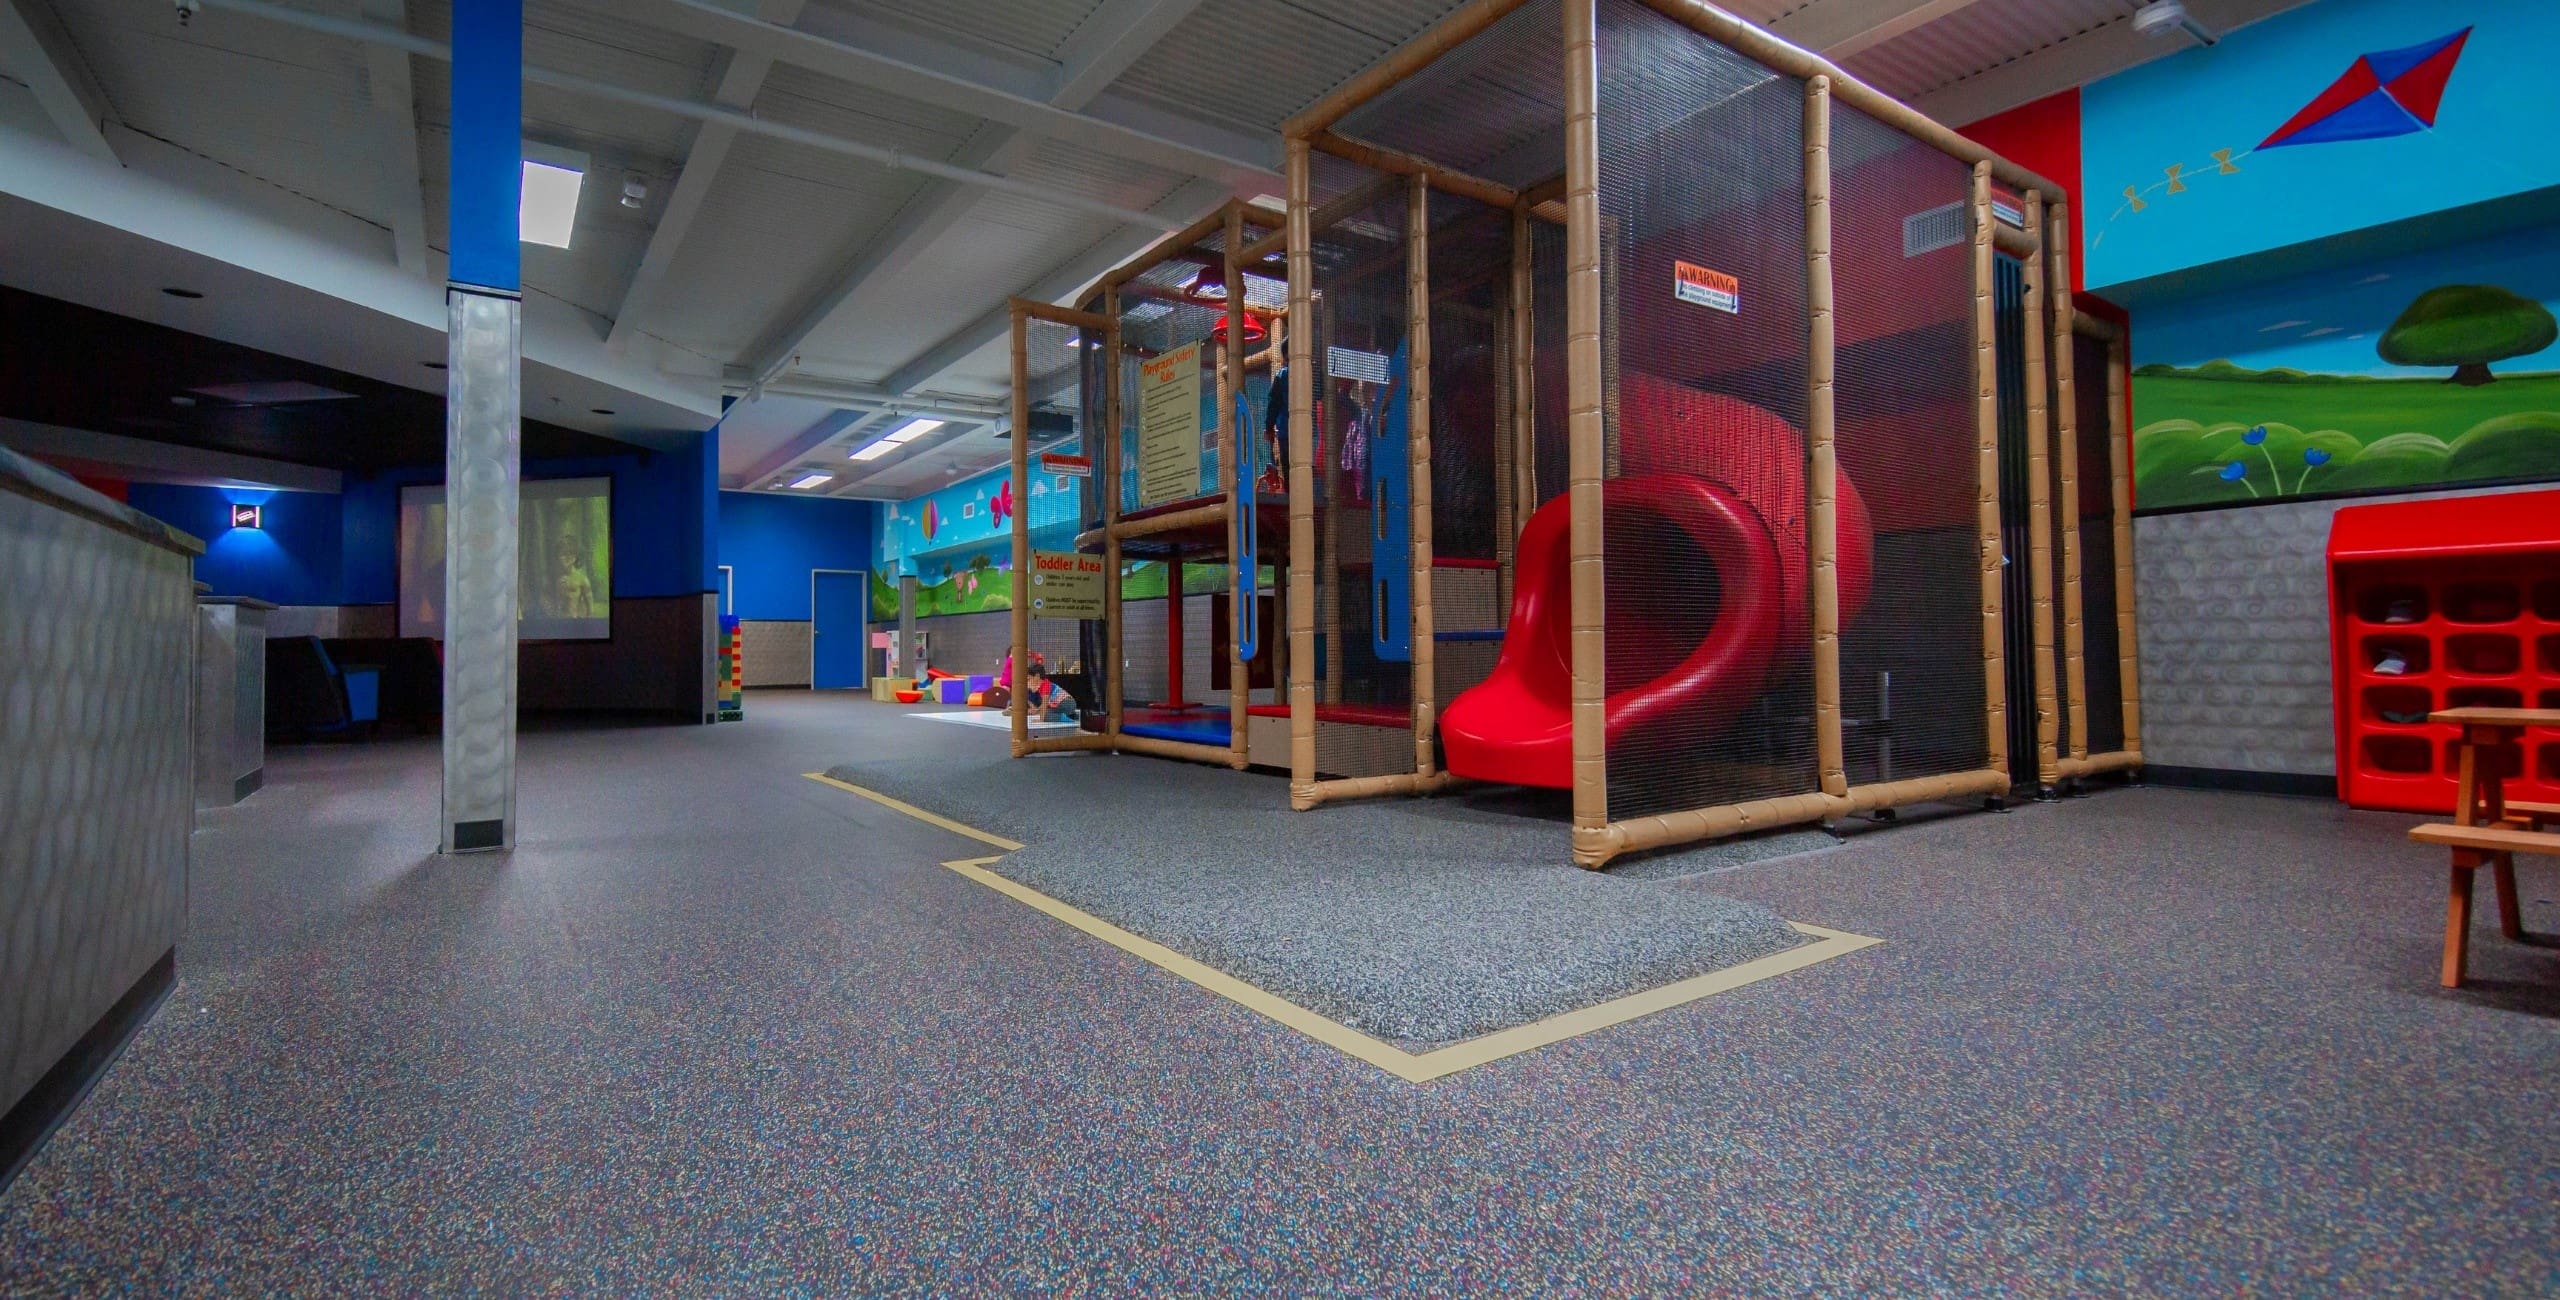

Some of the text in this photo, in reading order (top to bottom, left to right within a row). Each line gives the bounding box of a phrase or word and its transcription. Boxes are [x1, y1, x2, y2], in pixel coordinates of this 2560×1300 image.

[1689, 267, 1732, 292] WARNING
[1035, 555, 1102, 573] Toddler Area
